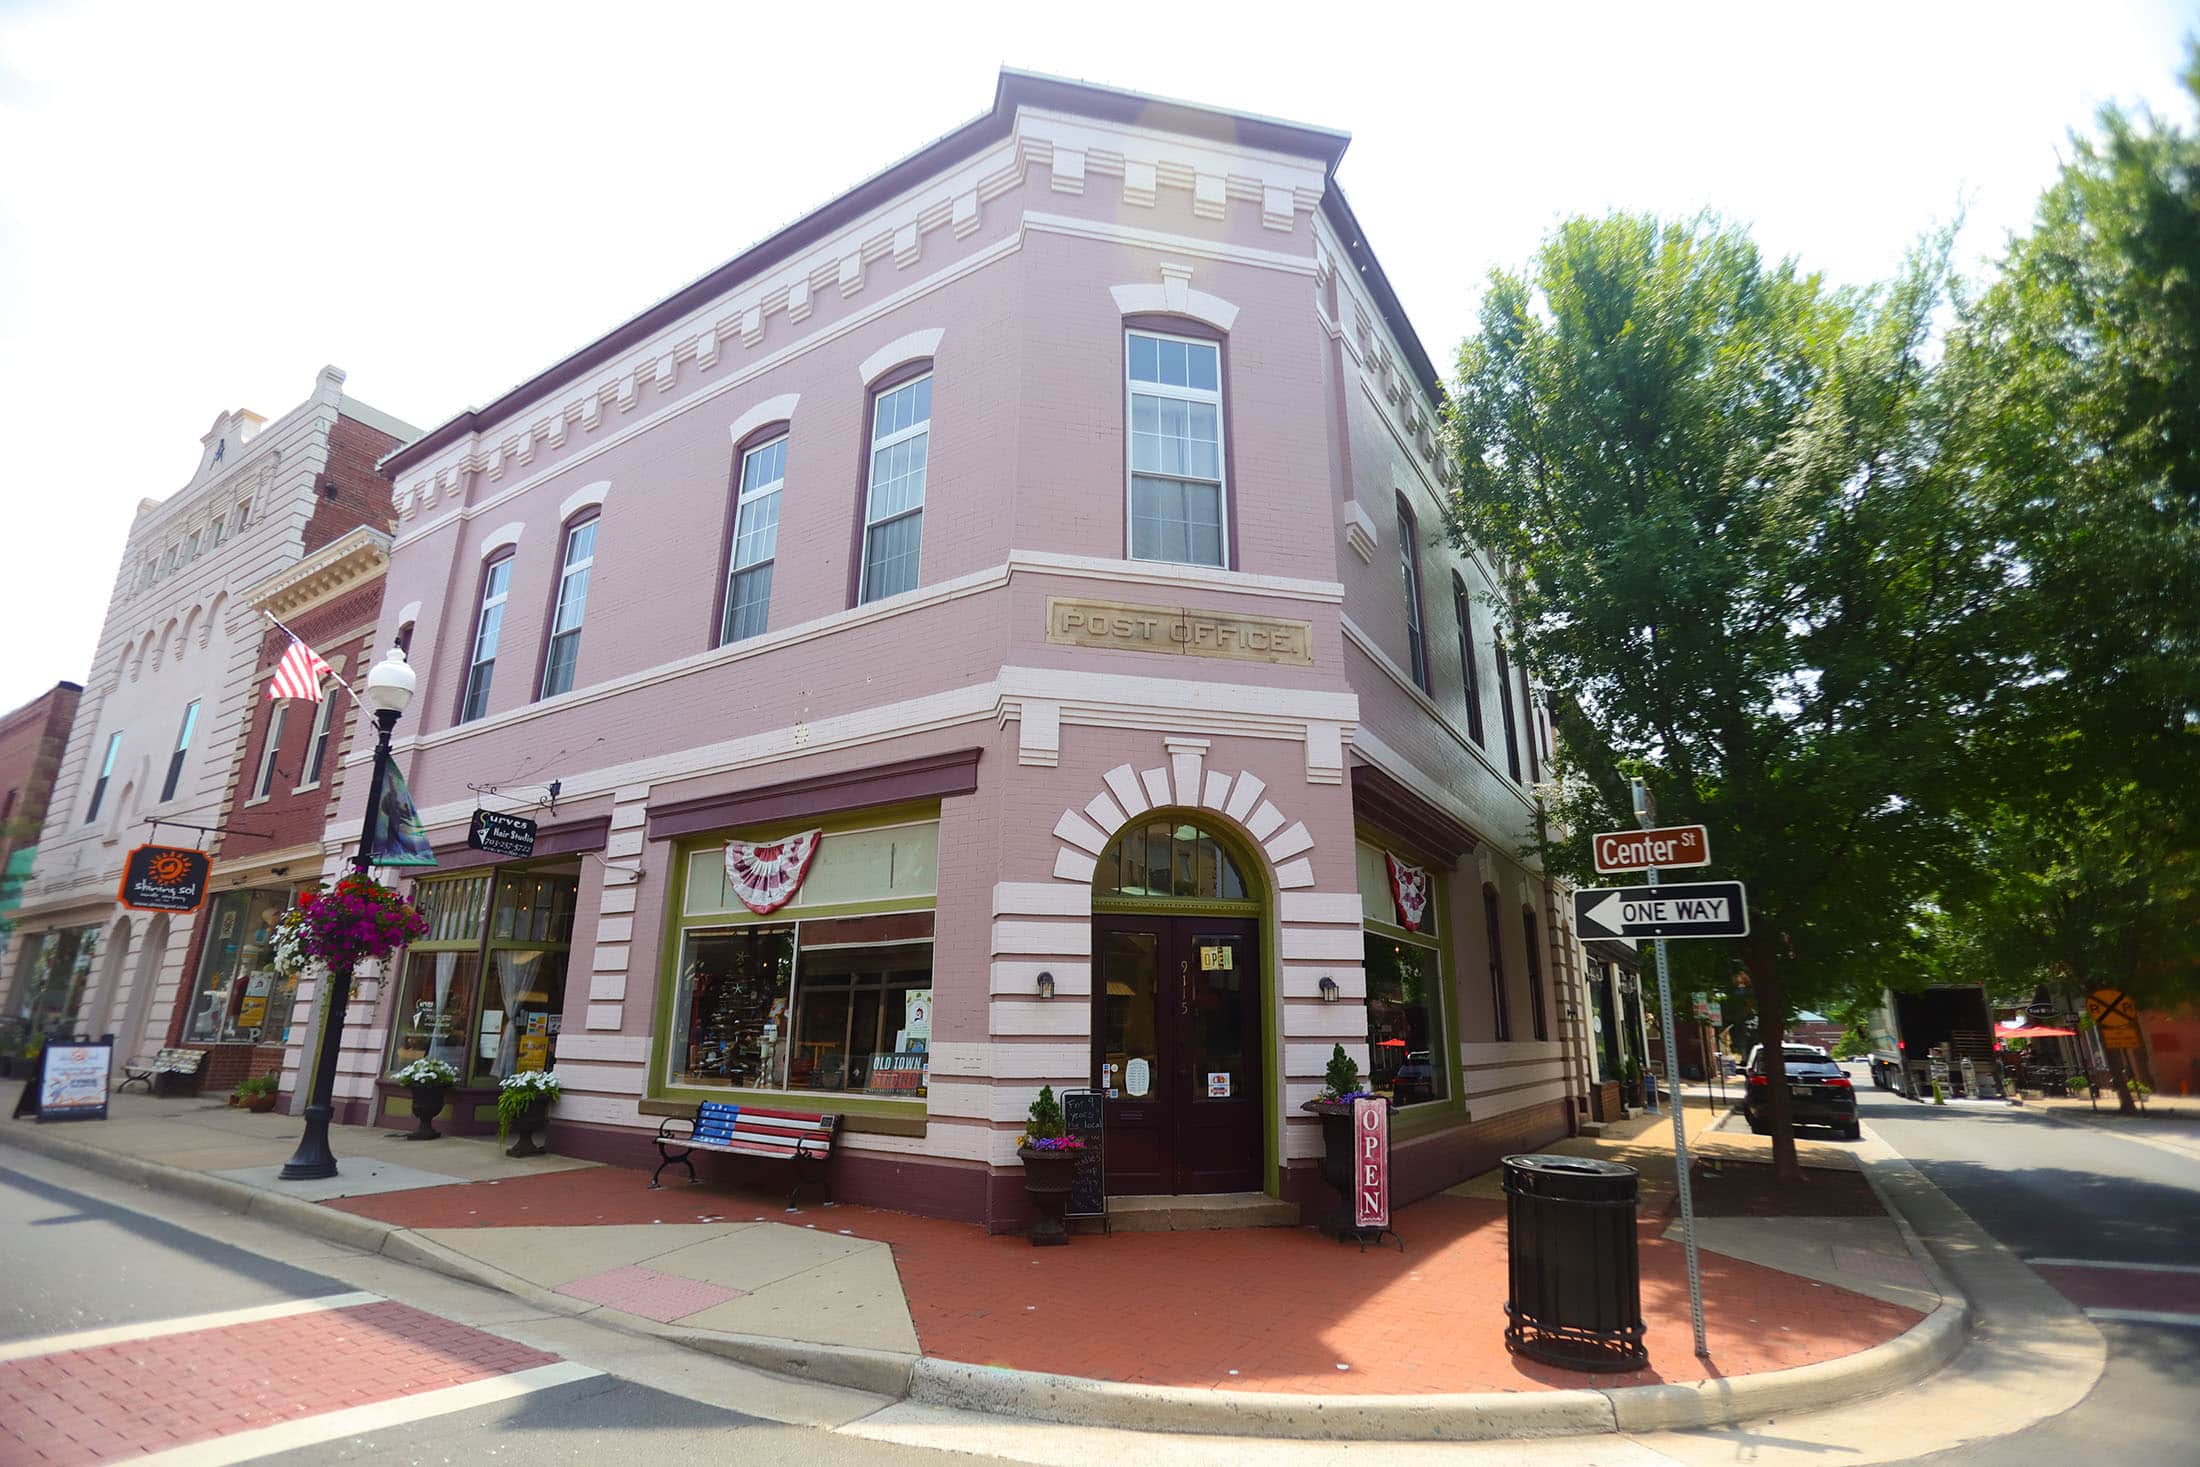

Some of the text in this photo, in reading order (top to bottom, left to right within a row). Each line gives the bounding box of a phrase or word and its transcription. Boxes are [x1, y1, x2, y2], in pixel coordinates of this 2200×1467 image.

[1061, 607, 1158, 641] POST
[493, 827, 534, 845] Hair Studio
[1602, 832, 1697, 866] Center St
[134, 879, 175, 896] shining
[178, 884, 196, 896] sol
[1622, 899, 1724, 923] ONE WAY
[1180, 960, 1189, 1016] 9115
[873, 1056, 922, 1070] OLD TOWN
[1362, 1109, 1381, 1215] OPEN
